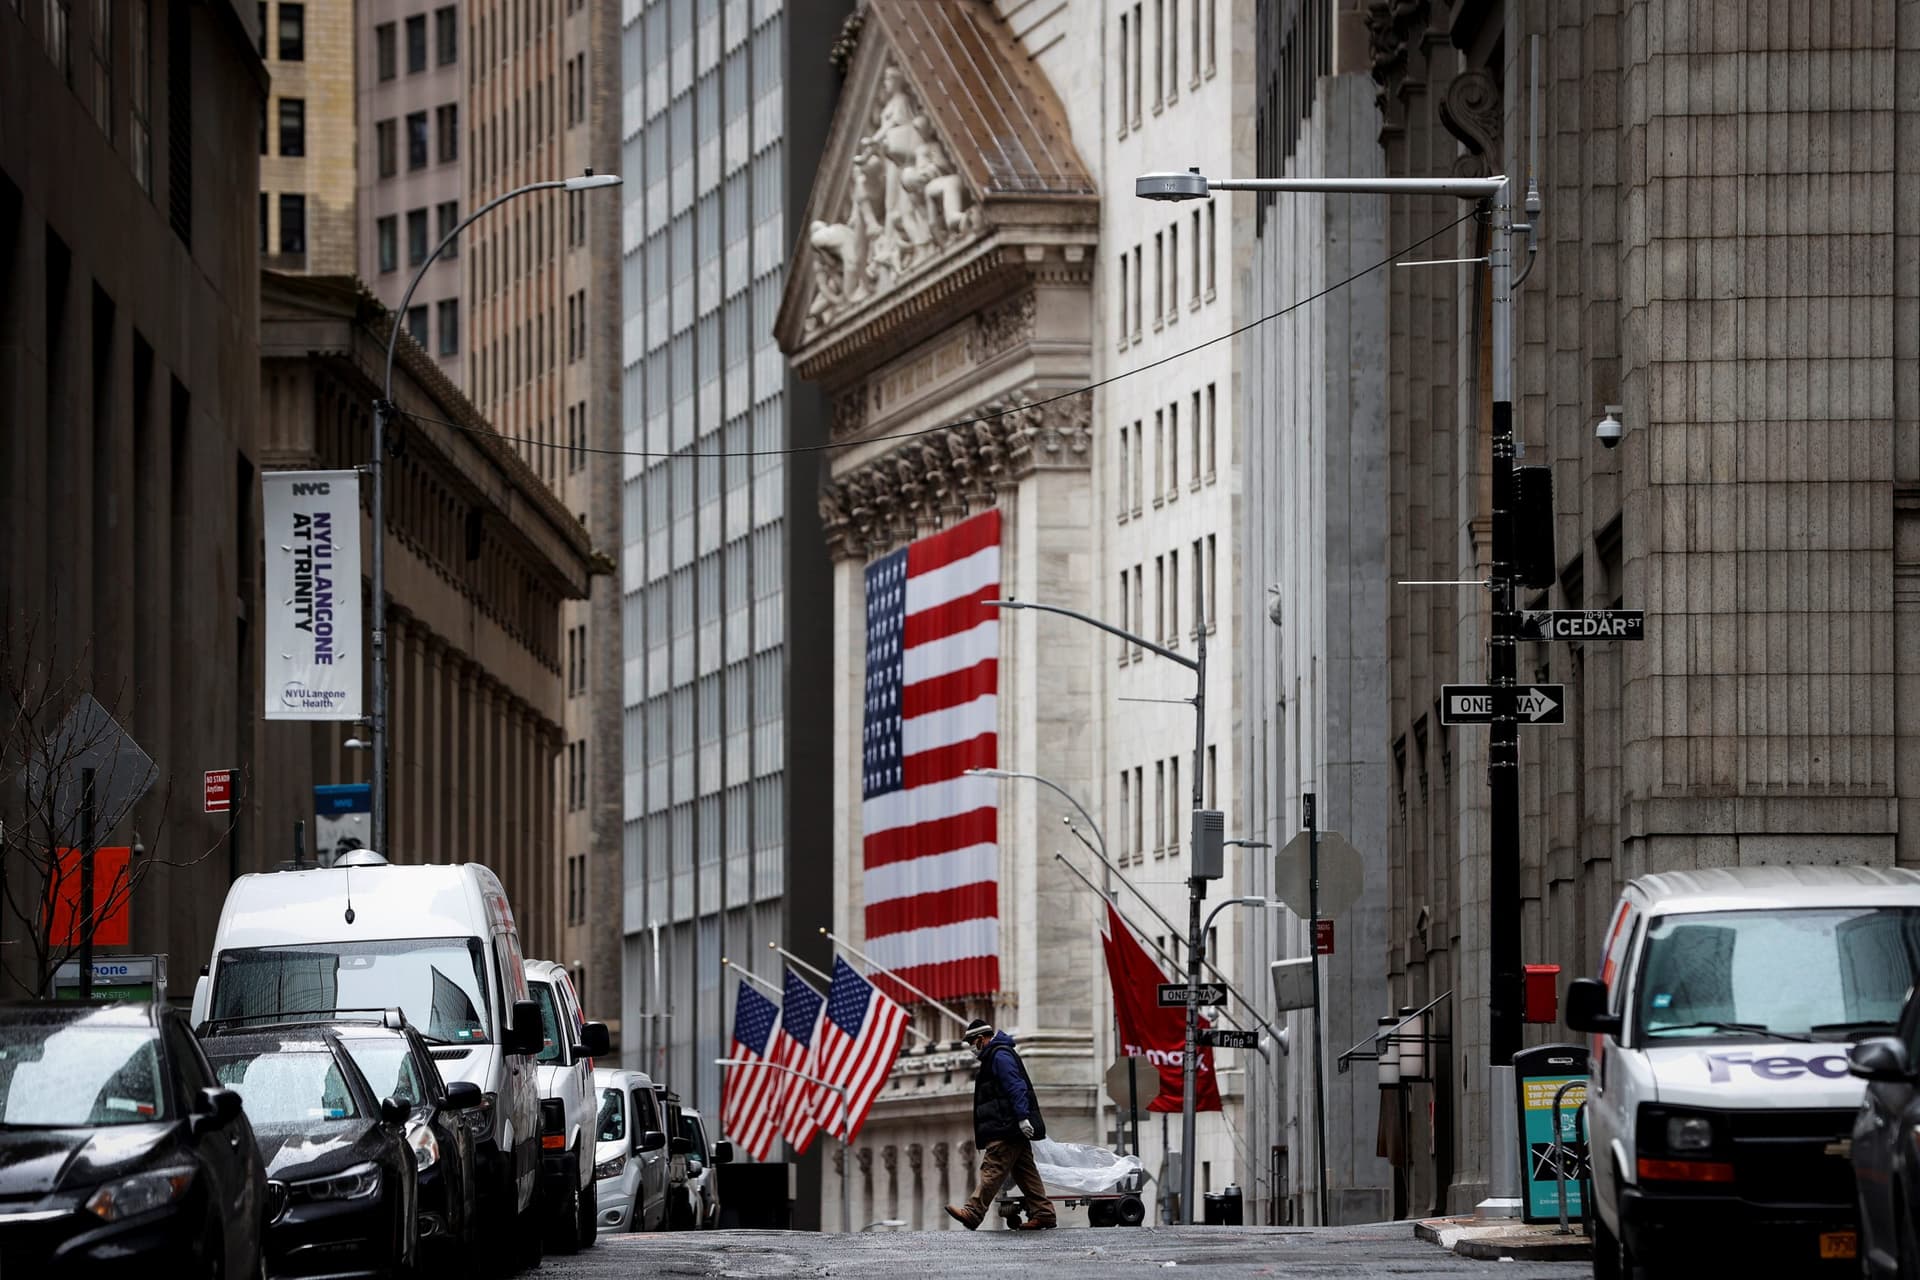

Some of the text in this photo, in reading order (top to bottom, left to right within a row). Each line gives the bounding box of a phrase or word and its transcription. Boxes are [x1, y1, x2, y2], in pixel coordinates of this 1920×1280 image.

[292, 483, 330, 496] NYC
[293, 512, 313, 632] AT TRINITY
[313, 512, 333, 665] NYU LANGONE
[1556, 618, 1641, 636] CEDAR ST
[285, 689, 346, 701] NYU Langone
[302, 699, 334, 708] Health
[1460, 697, 1492, 713] ONE
[1223, 1034, 1244, 1048] Pine
